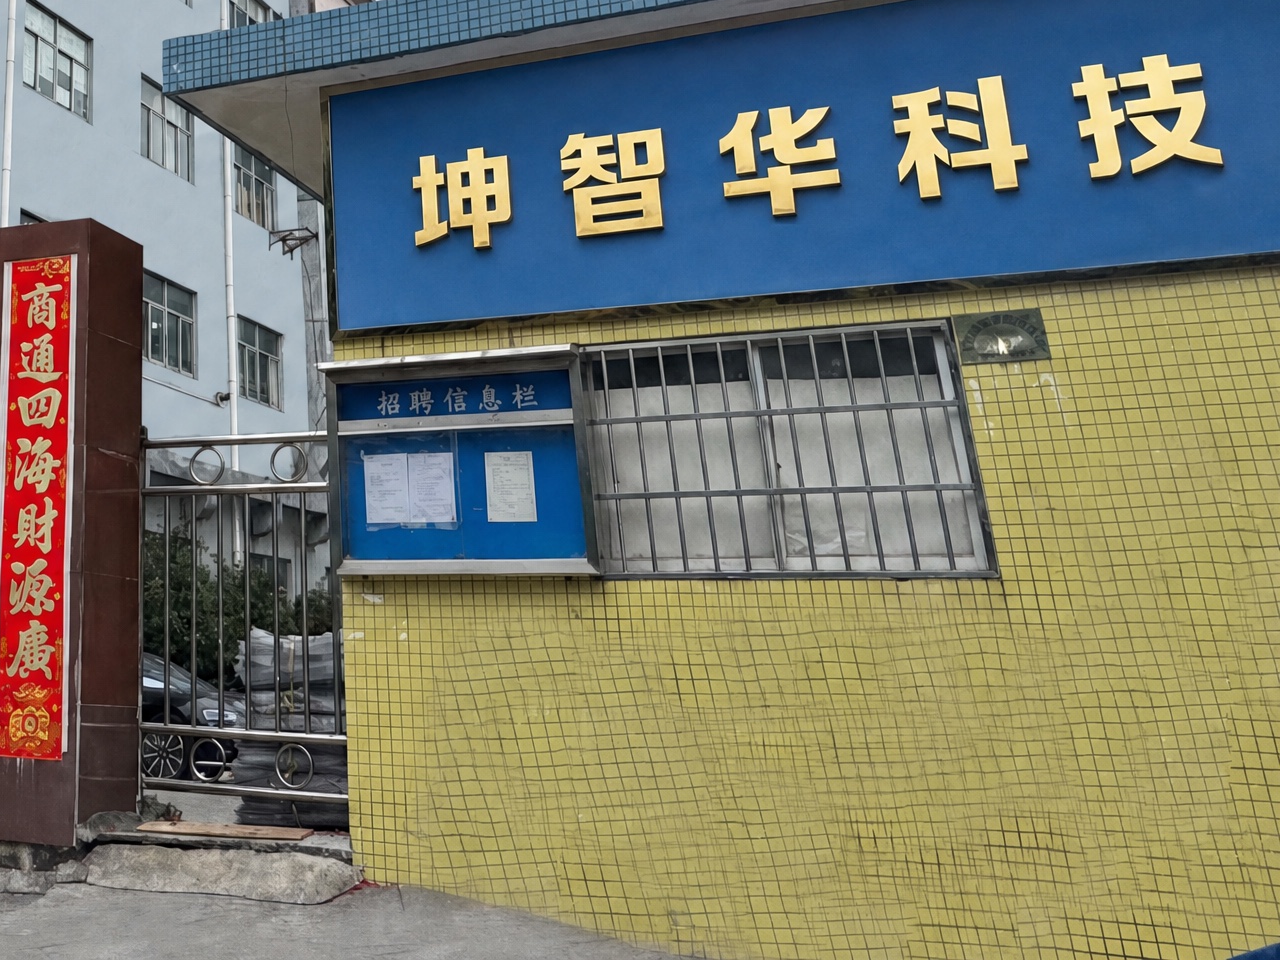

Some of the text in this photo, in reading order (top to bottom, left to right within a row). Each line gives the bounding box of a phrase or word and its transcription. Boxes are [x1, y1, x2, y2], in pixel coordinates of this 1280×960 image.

[412, 53, 1224, 249] 坤智华科技
[7, 283, 63, 680] 商通四海財源廣
[377, 383, 539, 416] 招聘信息栏
